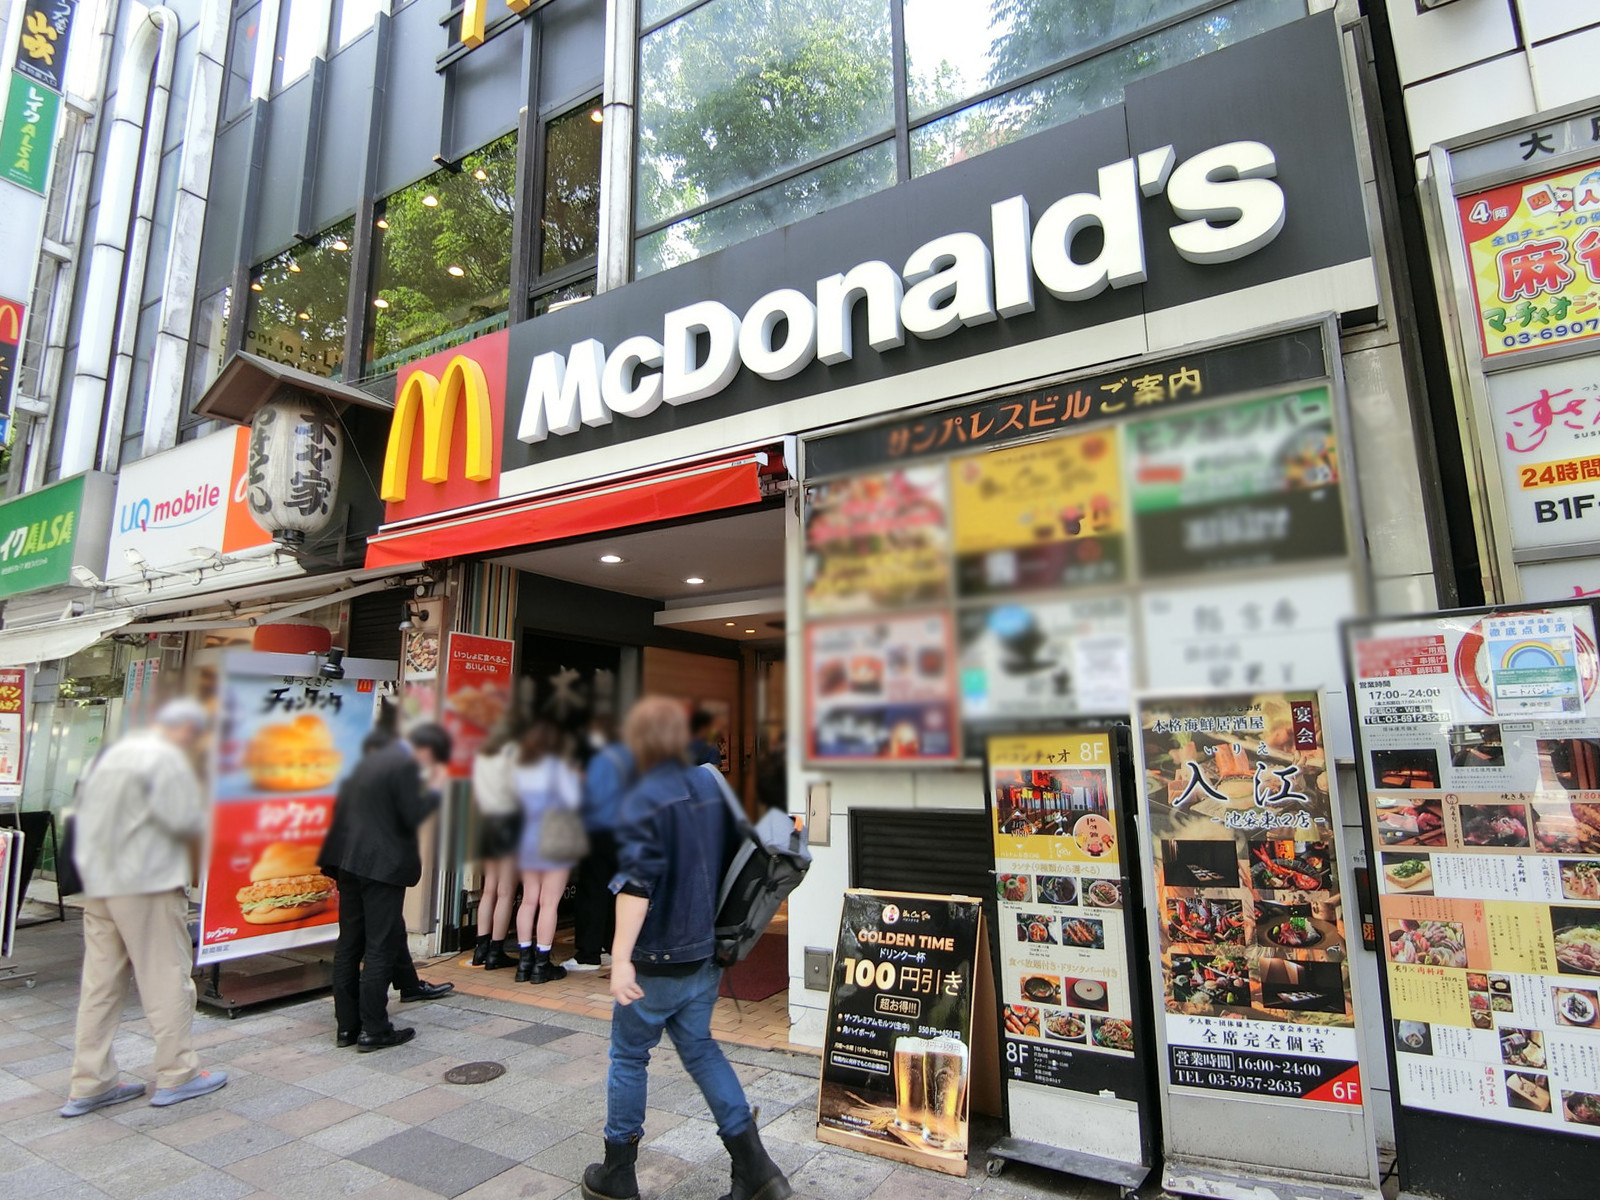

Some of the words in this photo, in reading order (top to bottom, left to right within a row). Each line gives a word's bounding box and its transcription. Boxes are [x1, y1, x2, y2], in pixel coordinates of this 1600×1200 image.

[517, 140, 1286, 444] McDonald's
[119, 497, 151, 534] UQ
[153, 483, 220, 523] mobile
[1152, 715, 1265, 733] 本格海鮮居酒屋
[1293, 705, 1314, 745] 宴会
[1079, 742, 1104, 762] 8F
[1203, 741, 1270, 755] いりえ
[1172, 761, 1309, 808] 入江
[858, 928, 915, 948] GOLDEN
[918, 935, 955, 951] TIME
[1006, 1041, 1029, 1064] 8F
[1201, 1028, 1326, 1054] 全席完全個室
[1175, 1050, 1232, 1069] 営業時間
[1175, 1069, 1204, 1084] TEL
[1208, 1073, 1302, 1093] 03-5957-2635
[1332, 1080, 1358, 1100] 6F
